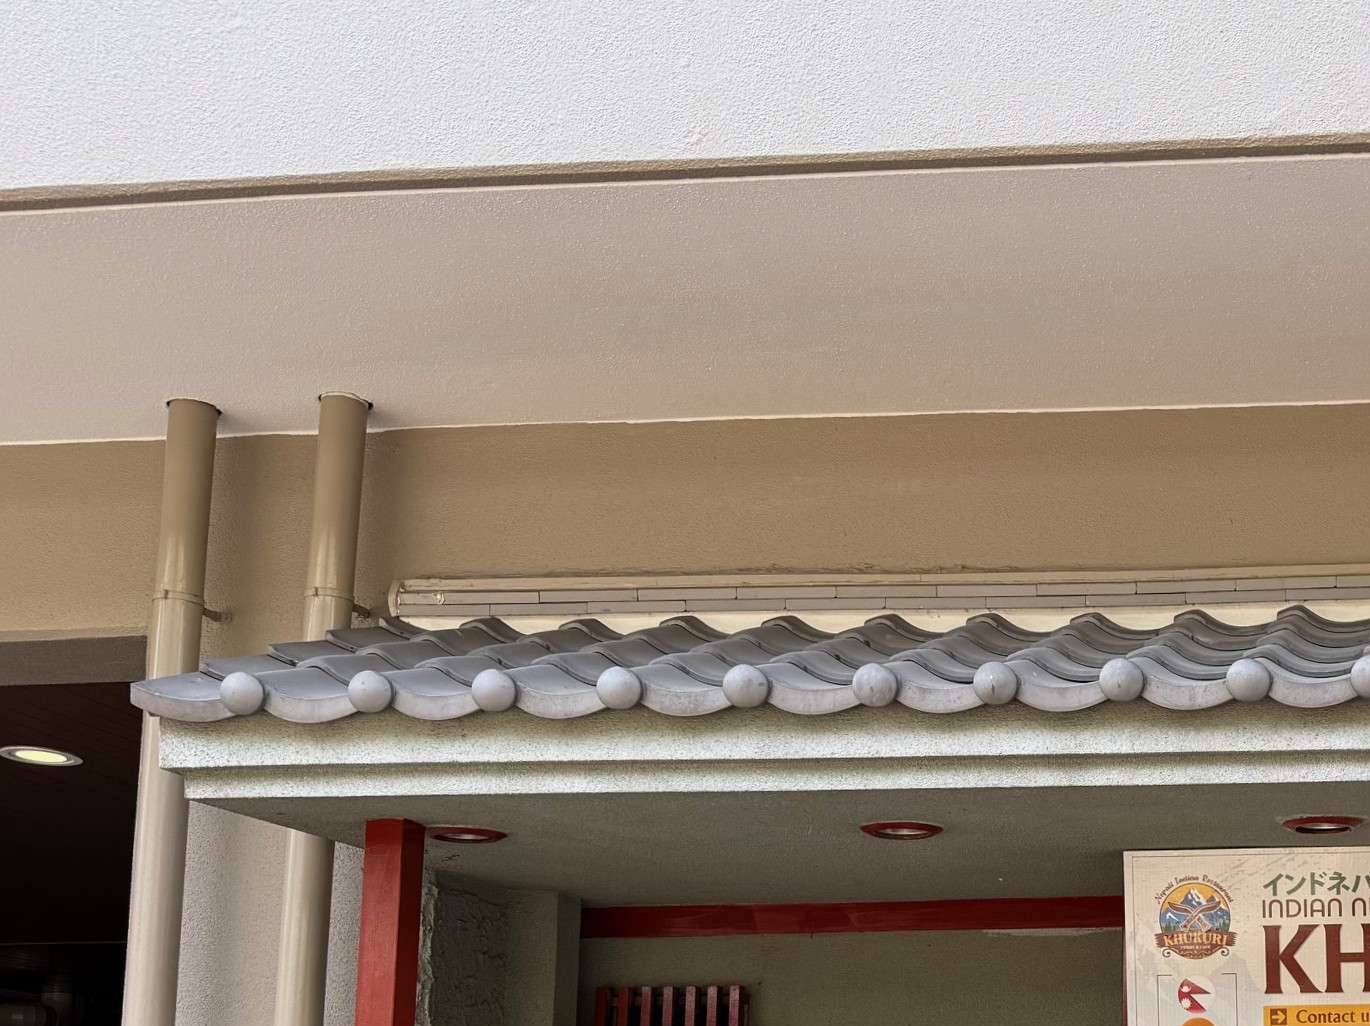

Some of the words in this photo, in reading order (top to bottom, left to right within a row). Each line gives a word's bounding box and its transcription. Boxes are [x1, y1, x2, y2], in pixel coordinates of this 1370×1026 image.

[1262, 899, 1344, 918] INDIAN
[1163, 932, 1228, 947] KHUKURI
[1296, 1008, 1354, 1024] Contact
